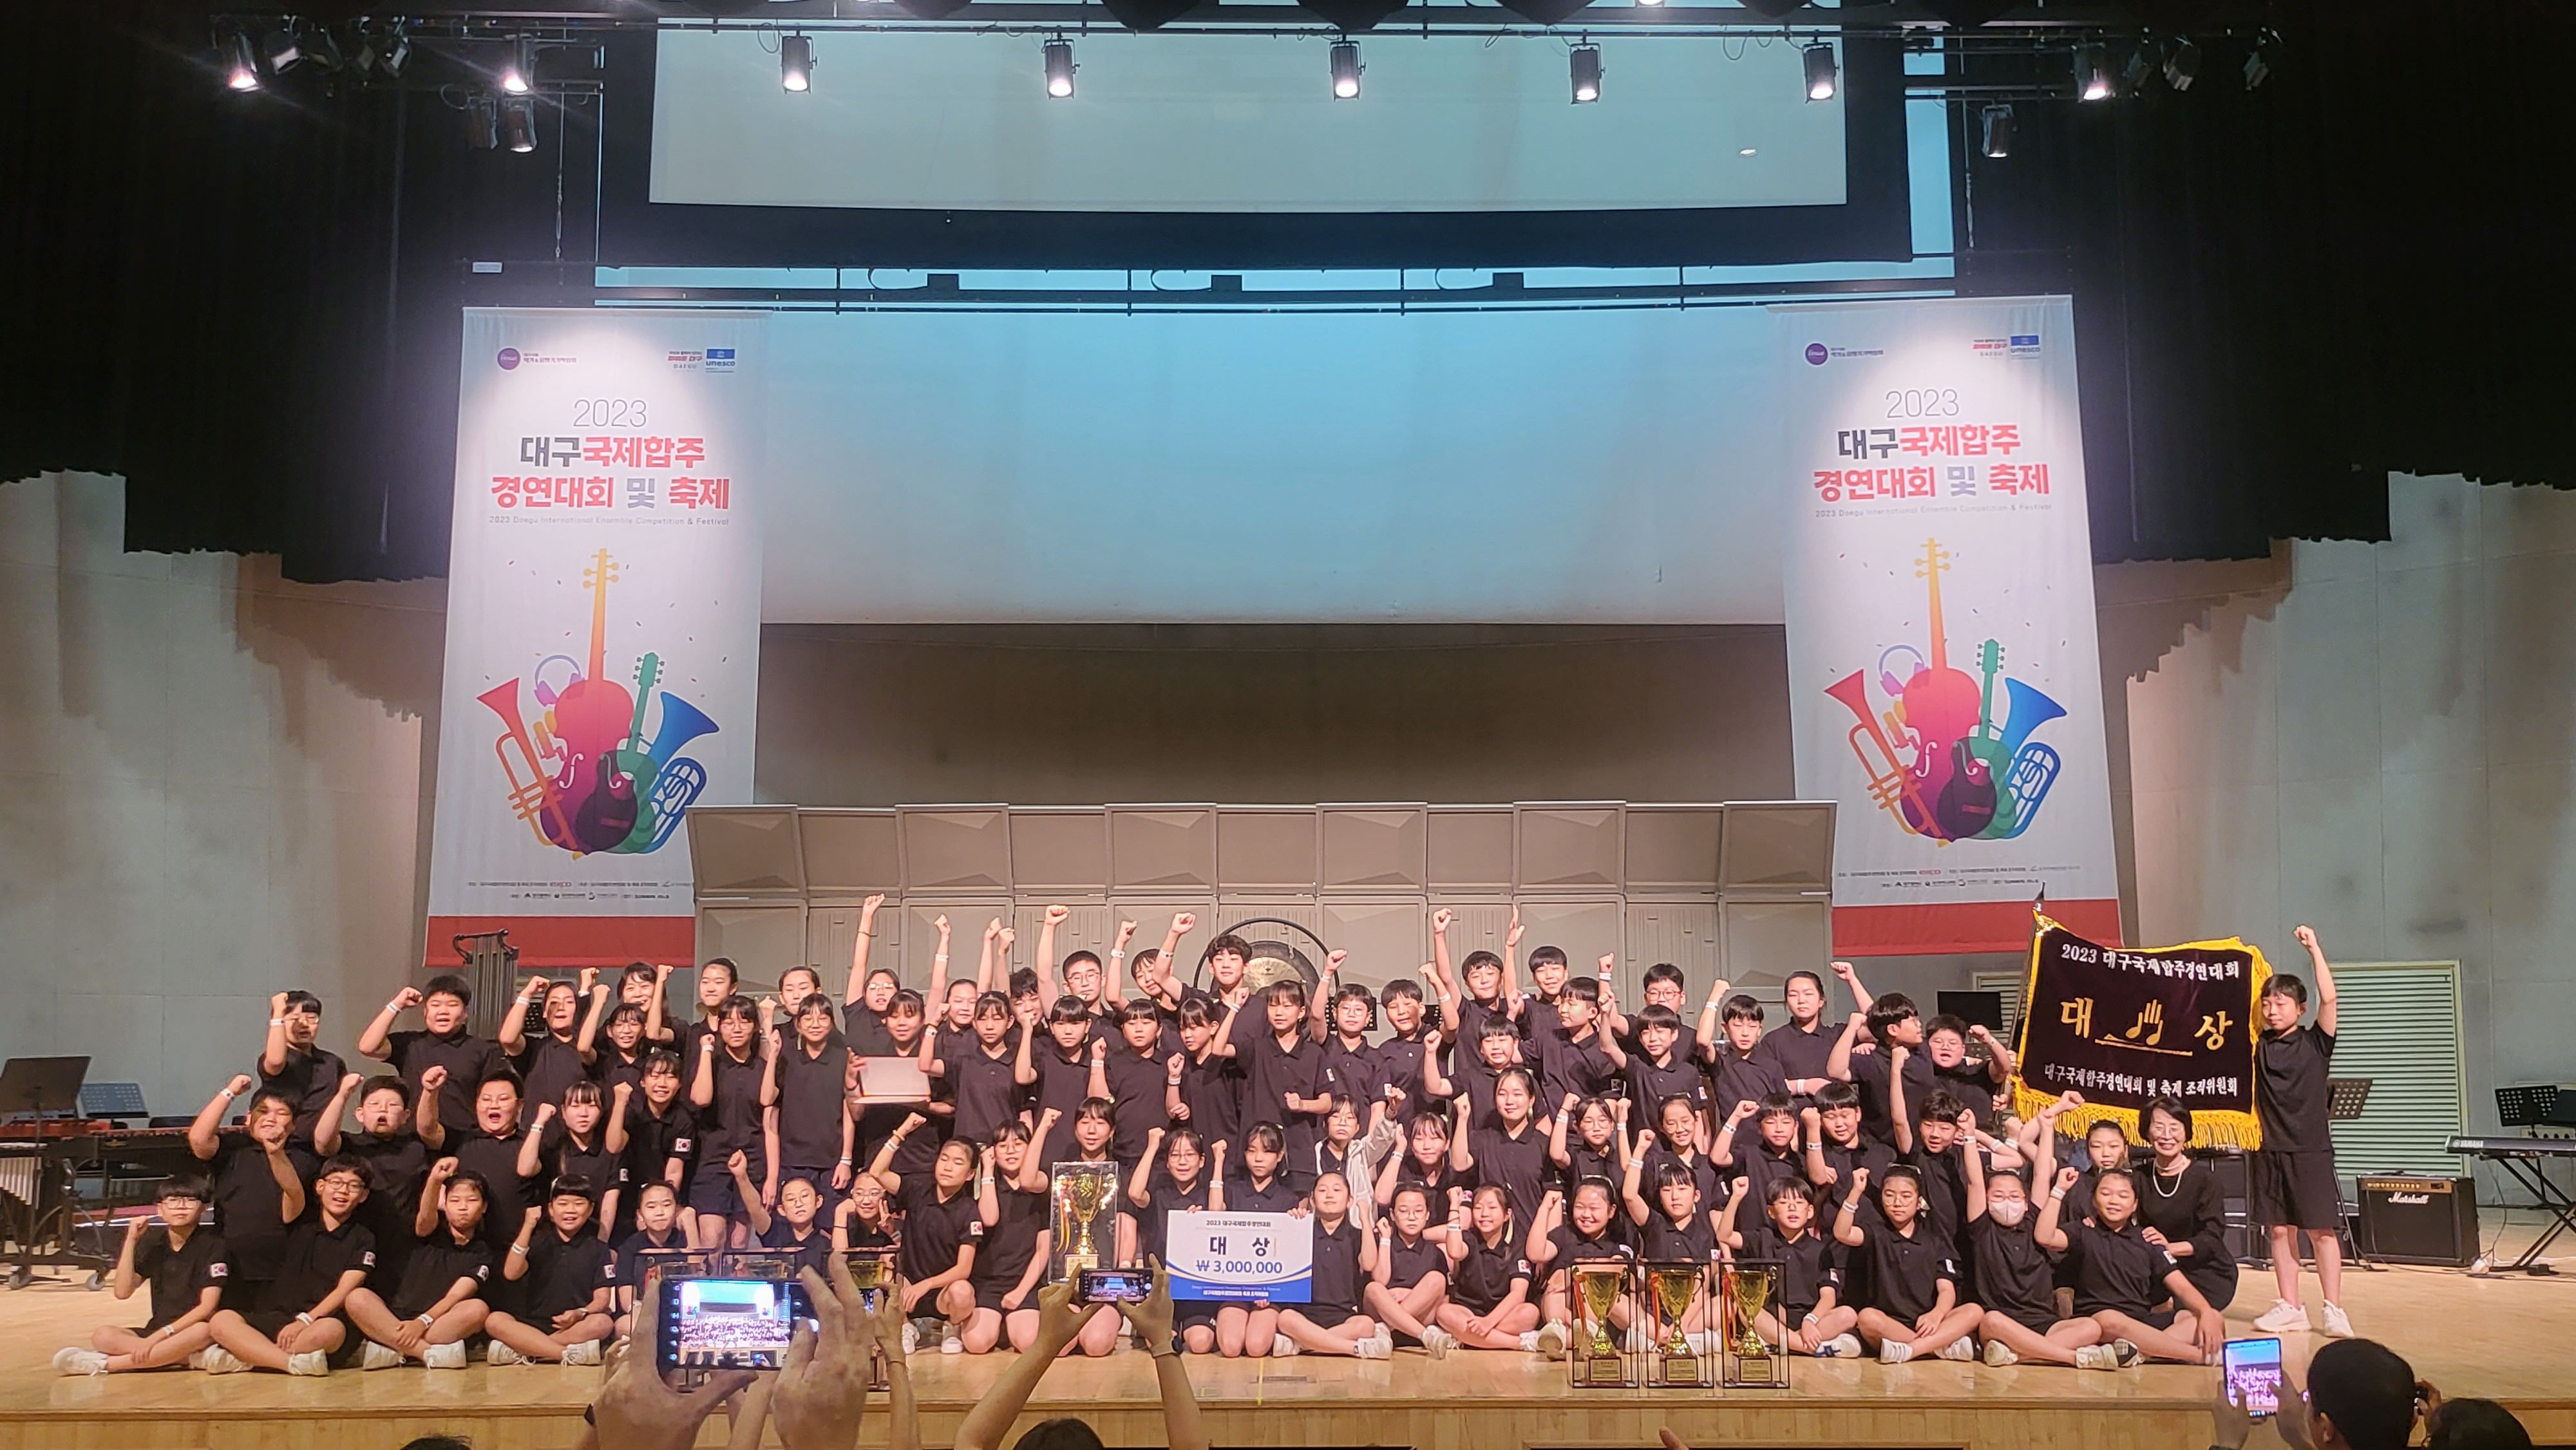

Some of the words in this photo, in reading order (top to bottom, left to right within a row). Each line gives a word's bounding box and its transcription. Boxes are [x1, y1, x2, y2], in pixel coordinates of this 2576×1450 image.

[573, 399, 647, 427] 2023
[1885, 389, 1959, 418] 2023
[520, 437, 705, 468] 대구국제합주
[1837, 424, 2021, 460] 대구국제합주
[491, 476, 613, 509] 경연대회
[627, 478, 655, 509] 및
[668, 477, 730, 509] 축제
[1814, 467, 1936, 502] 경연대회
[1947, 466, 1976, 496] 및
[1989, 464, 2050, 495] 축제
[2061, 943, 2098, 963] 2023
[2102, 951, 2239, 981] 대구국제합주경연대회
[2060, 997, 2094, 1039] 대
[2194, 1011, 2233, 1051] 상
[2045, 1063, 2143, 1095] 대구국제합주경연대회
[2146, 1078, 2156, 1097] 및
[2160, 1079, 2182, 1098] 축제
[2388, 1191, 2429, 1204] Marshall
[1209, 1236, 1227, 1255] 대
[1251, 1237, 1271, 1256] 상
[1213, 1261, 1282, 1275] 3,000,000
